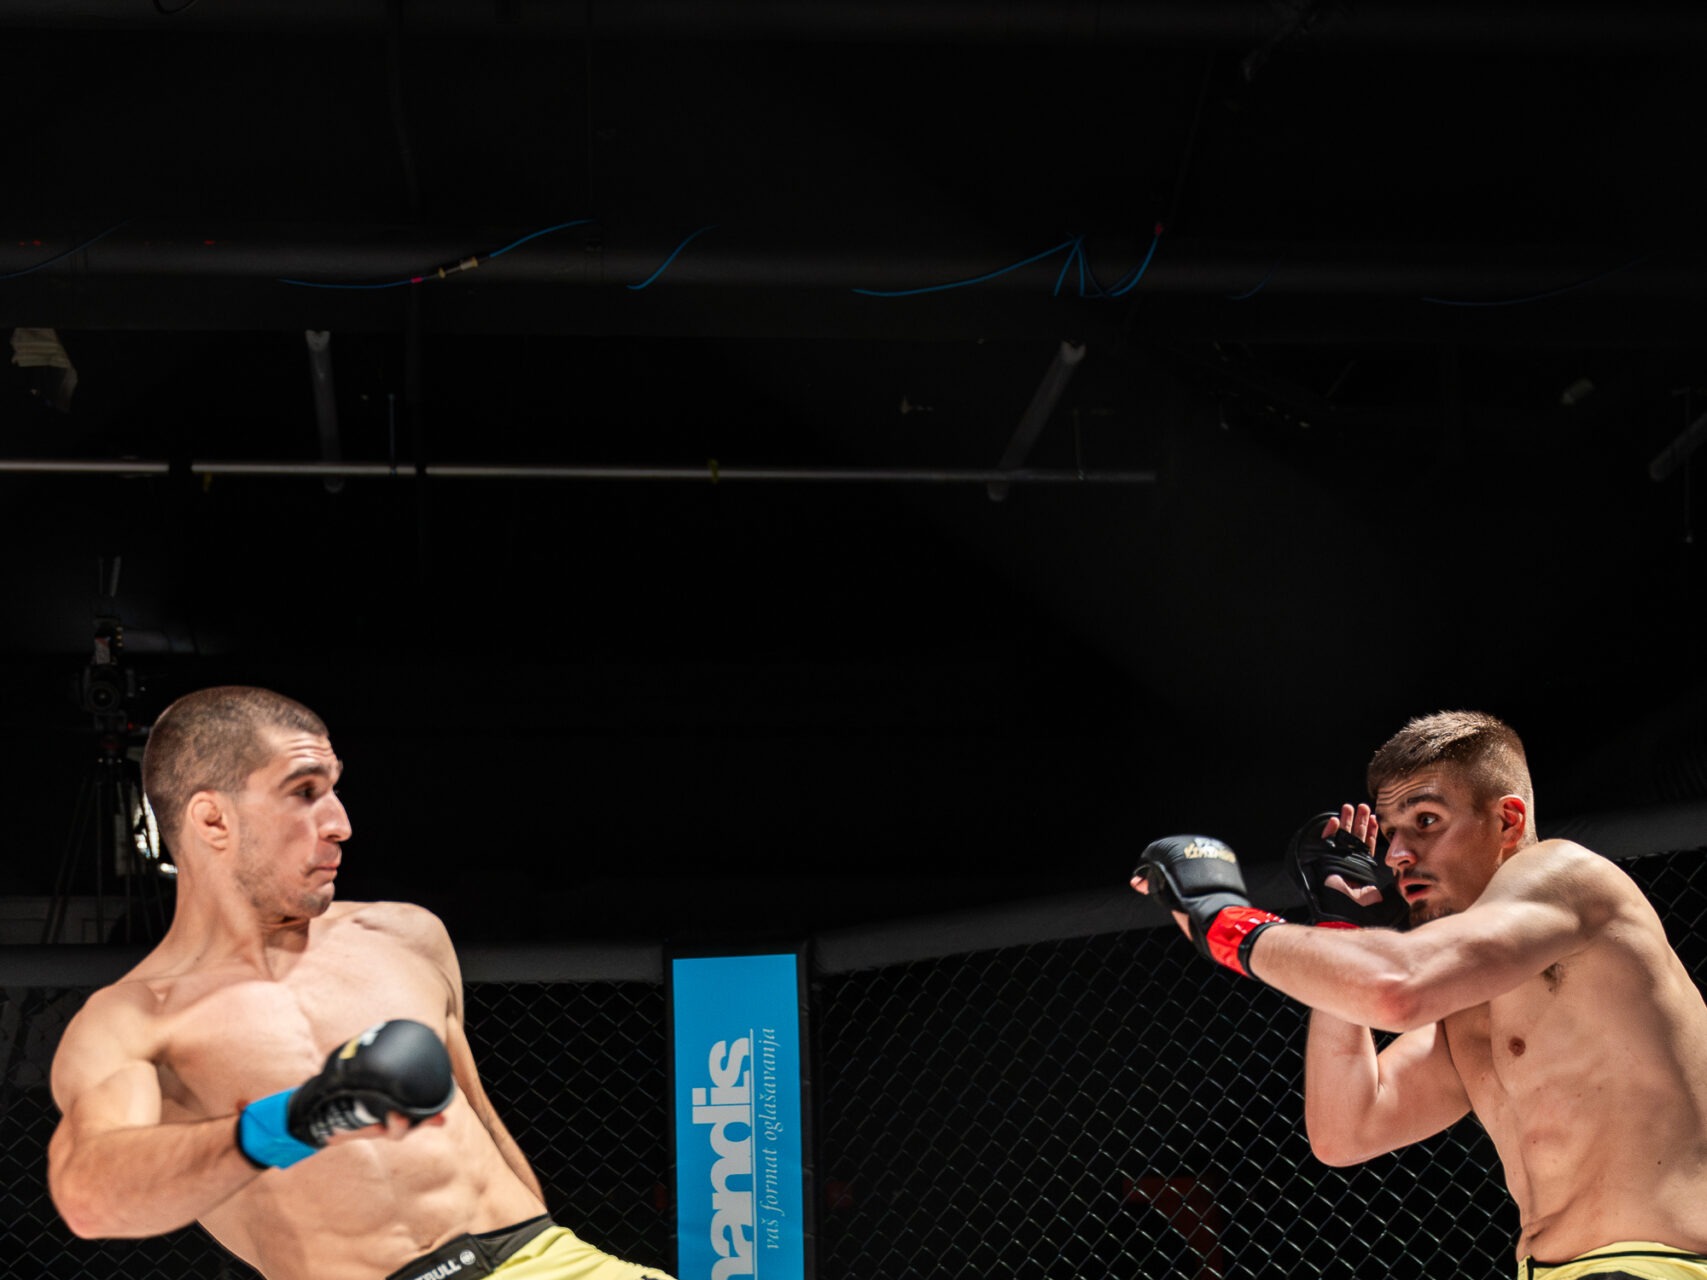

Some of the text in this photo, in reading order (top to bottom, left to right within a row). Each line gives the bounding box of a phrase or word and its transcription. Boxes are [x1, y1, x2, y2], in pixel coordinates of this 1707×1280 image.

[758, 1028, 785, 1250] vaš format oglašavanja
